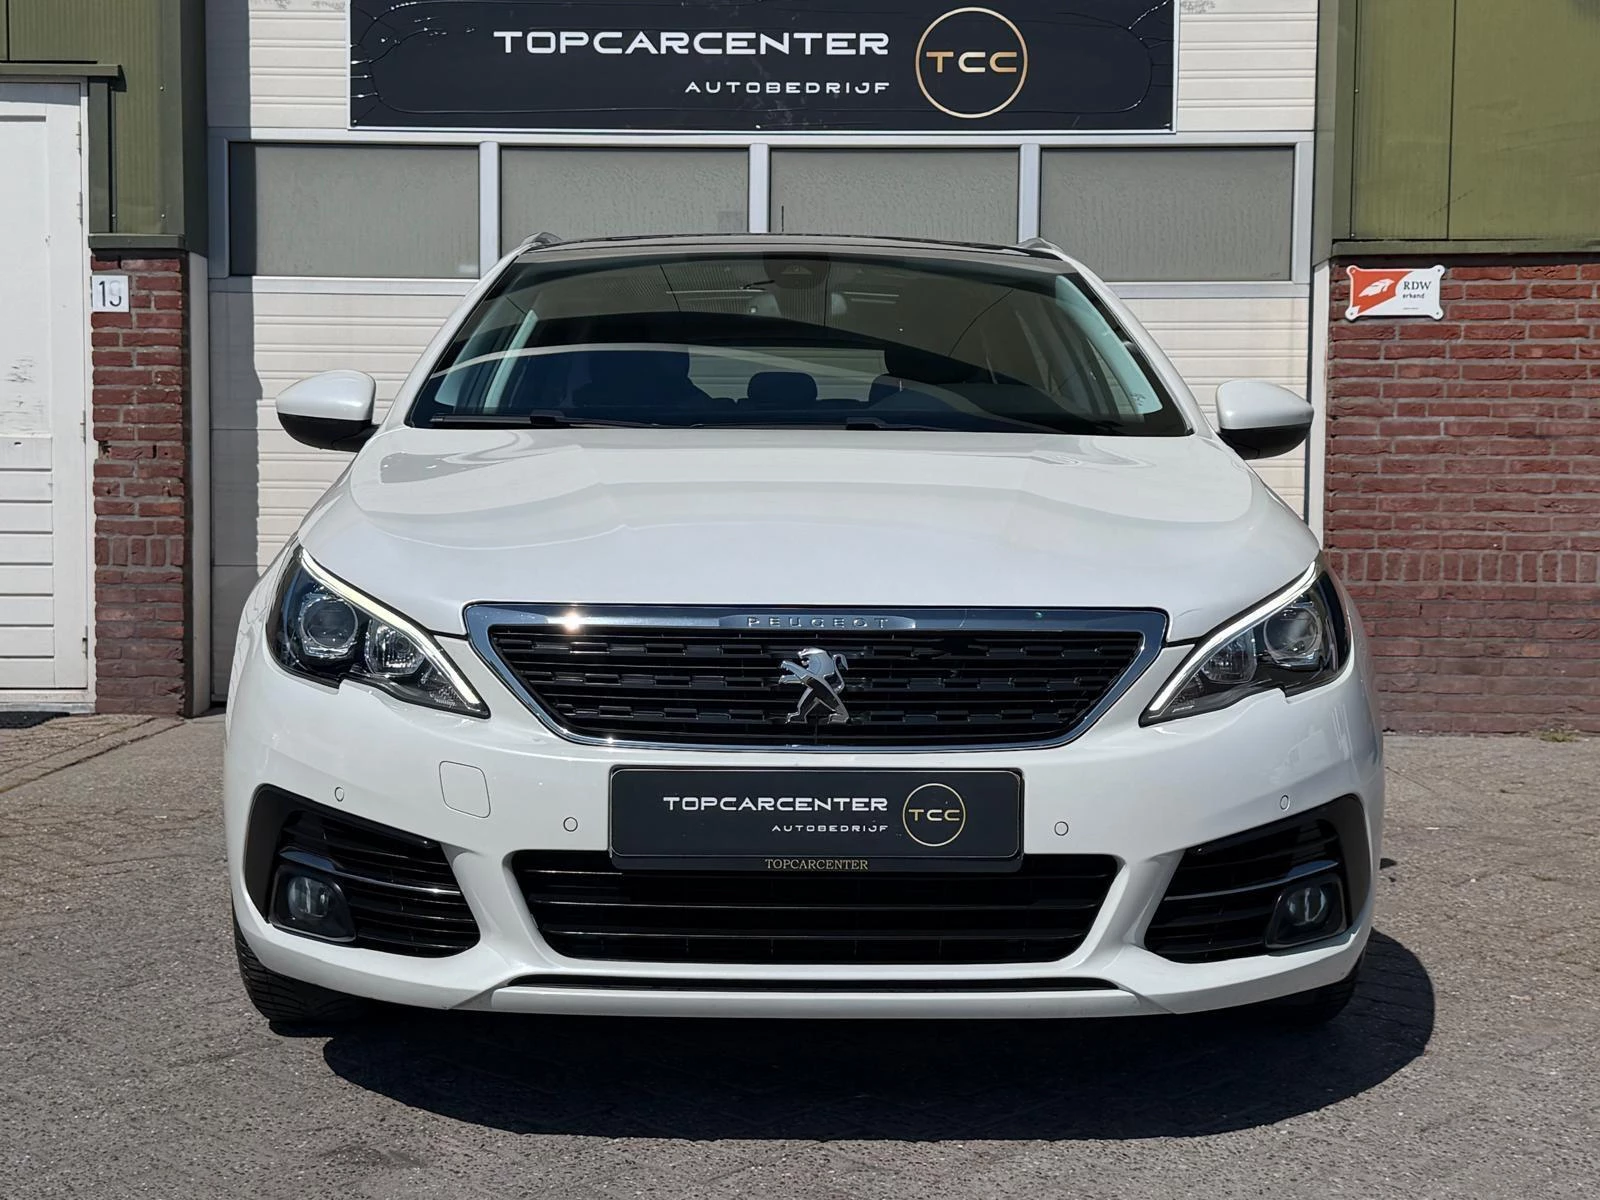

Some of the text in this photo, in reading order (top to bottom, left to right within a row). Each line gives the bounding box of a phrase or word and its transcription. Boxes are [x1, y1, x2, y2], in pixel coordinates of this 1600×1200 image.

[493, 31, 889, 56] TOPCARCENTER
[926, 51, 1017, 73] TCC
[685, 81, 890, 95] AUTOBEDRIJF
[1403, 281, 1432, 291] RDW
[747, 616, 889, 629] PEUGEOT
[663, 796, 888, 812] TOPCARCENTER
[908, 808, 961, 822] TCC
[771, 824, 889, 833] AUTOBEDRIJF
[765, 858, 869, 870] TOPCARCENTER
